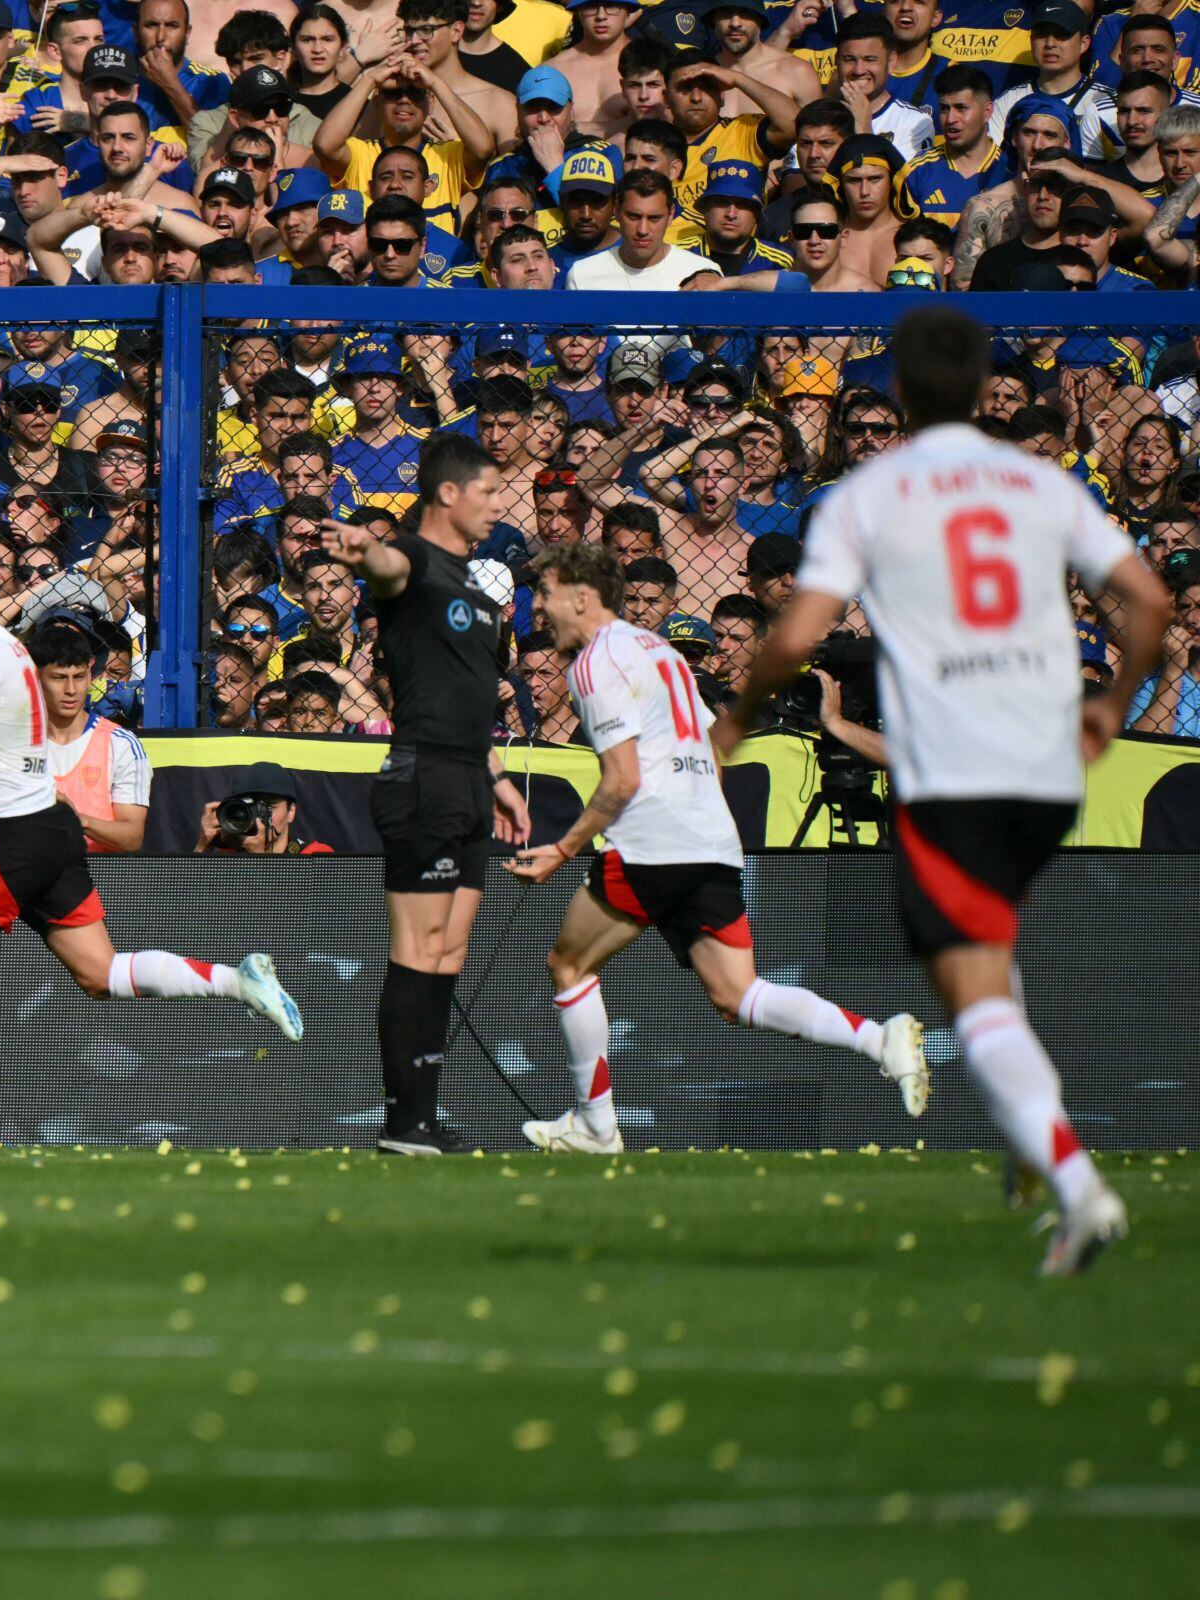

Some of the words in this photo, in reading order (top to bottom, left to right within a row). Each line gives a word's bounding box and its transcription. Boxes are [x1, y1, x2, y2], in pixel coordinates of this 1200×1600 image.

[942, 34, 999, 49] QATAR
[570, 157, 606, 178] BOCA
[944, 507, 1020, 630] 6
[656, 657, 702, 744] 11
